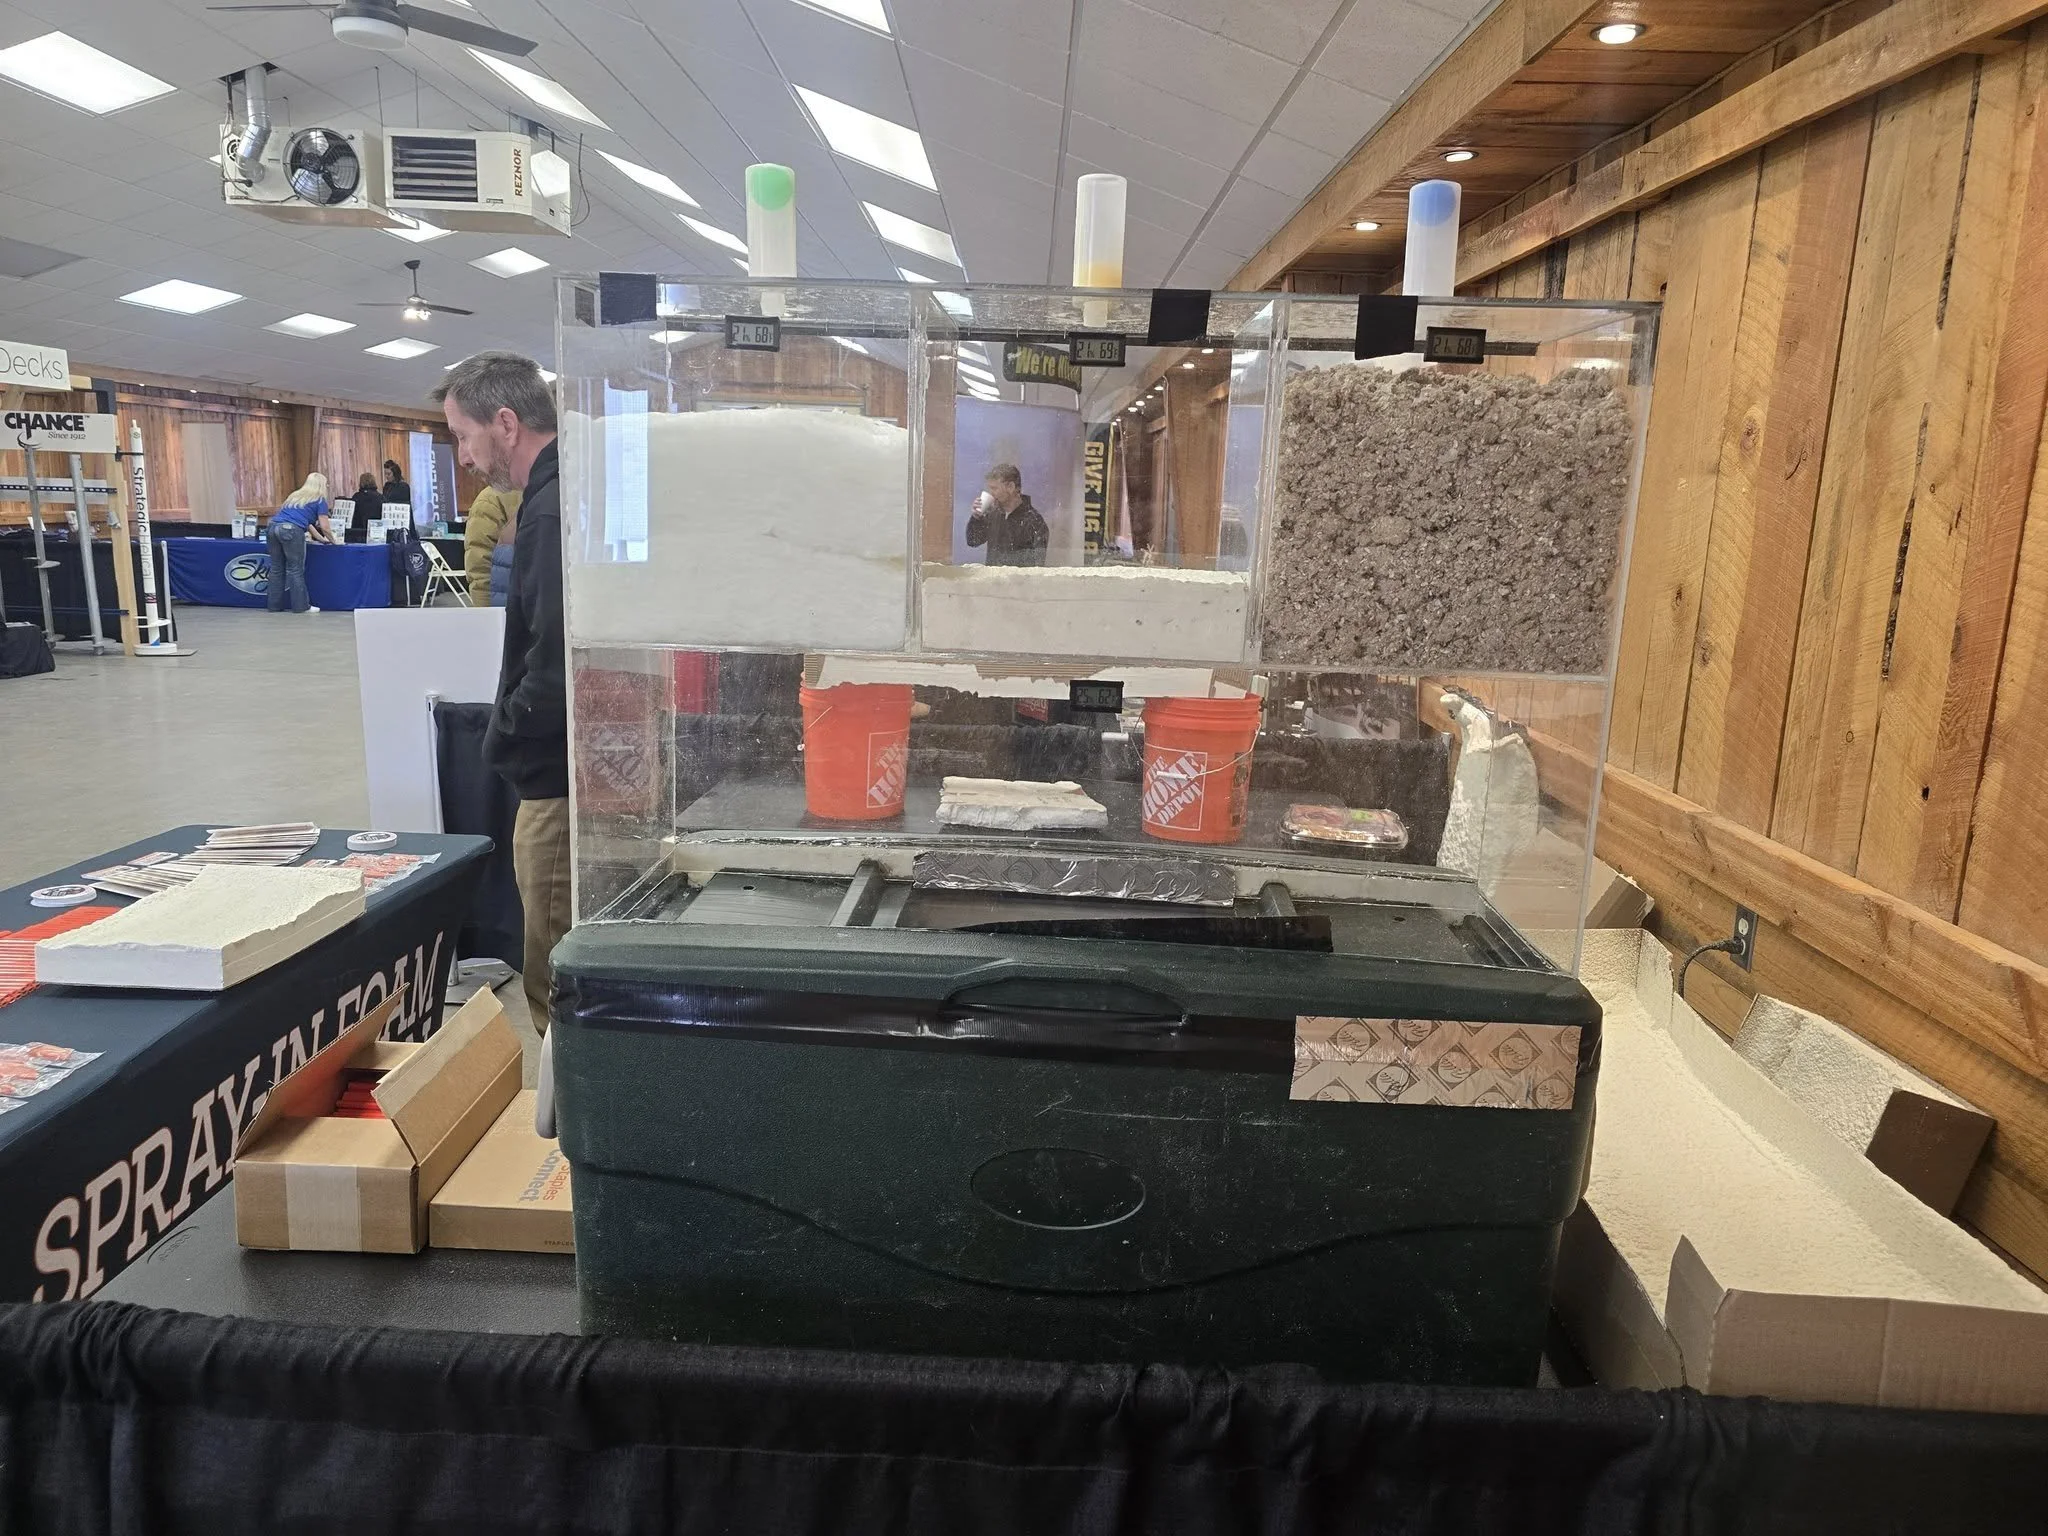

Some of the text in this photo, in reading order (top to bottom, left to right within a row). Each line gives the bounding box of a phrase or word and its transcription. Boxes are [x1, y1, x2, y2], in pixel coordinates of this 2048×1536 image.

[513, 148, 523, 197] REZNOR
[0, 347, 63, 380] Decks
[1014, 346, 1056, 377] We're
[4, 412, 85, 439] CHANCE
[48, 431, 69, 440] Since
[1085, 441, 1104, 494] GIVE
[132, 466, 147, 532] Strategic
[140, 534, 153, 580] Helical
[1143, 750, 1207, 820] HOME
[1146, 755, 1169, 784] THE
[1157, 781, 1202, 825] DEPOT
[337, 931, 444, 1042] FOAM
